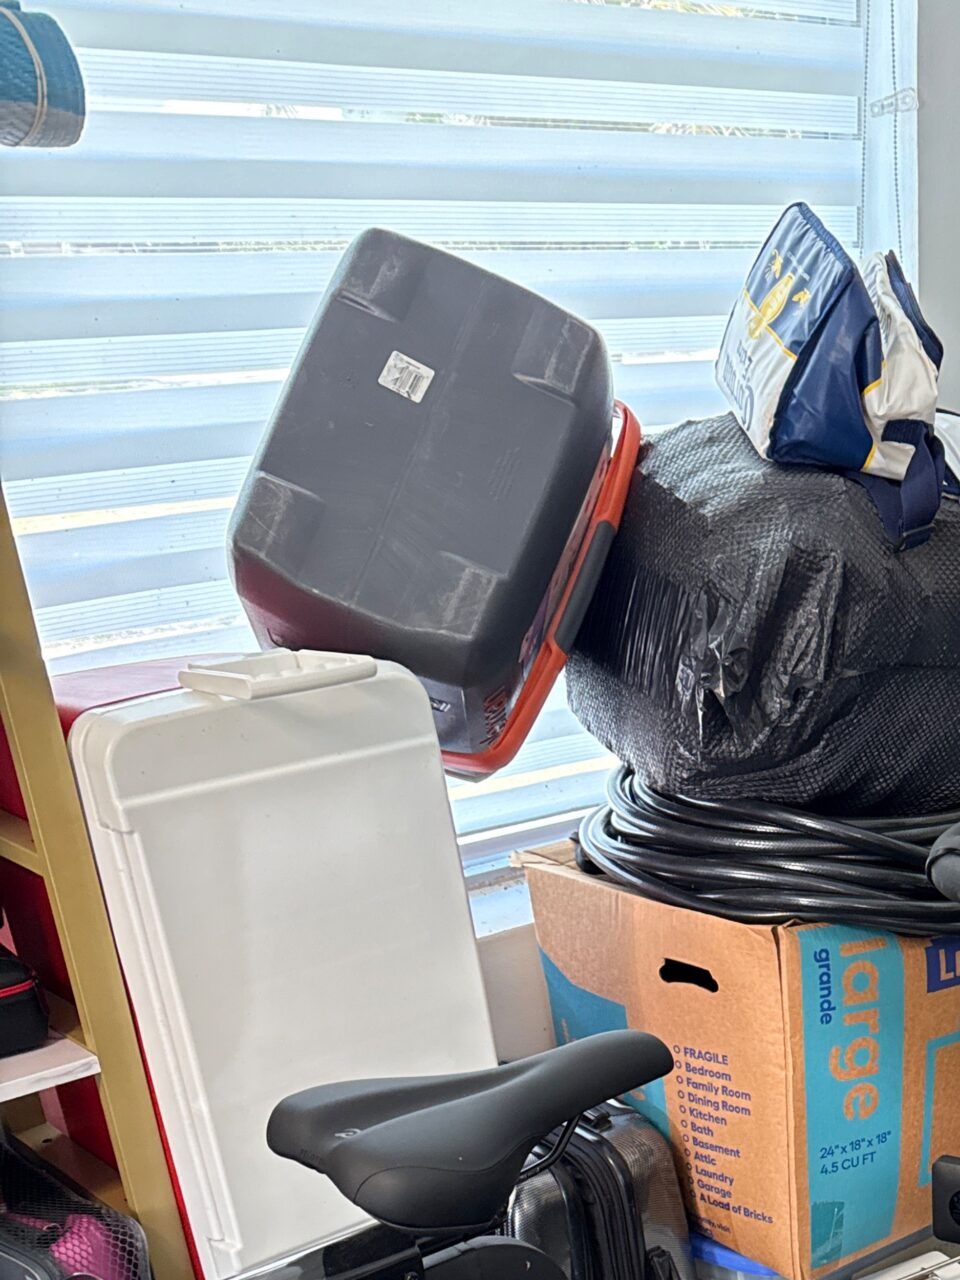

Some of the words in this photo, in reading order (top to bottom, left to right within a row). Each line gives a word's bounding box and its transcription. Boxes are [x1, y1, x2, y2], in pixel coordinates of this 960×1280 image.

[814, 948, 836, 1025] grande
[829, 938, 887, 1121] large
[684, 1047, 728, 1065] FRAGILE
[685, 1062, 732, 1082] Bedroom
[686, 1077, 720, 1096] Family
[722, 1086, 751, 1101] Room
[688, 1092, 720, 1111] Dining
[722, 1101, 750, 1116] Room
[689, 1107, 727, 1126] Kitchen
[691, 1122, 714, 1137] Bath
[692, 1137, 740, 1158] Basement
[694, 1151, 716, 1166] Attic
[820, 1158, 839, 1176] 4.5
[842, 1156, 862, 1170] CU
[862, 1152, 877, 1167] FT
[696, 1165, 734, 1186] Laundry
[697, 1178, 732, 1198] Garage
[700, 1194, 706, 1203] A
[708, 1196, 730, 1210] Load
[732, 1205, 742, 1214] of
[744, 1208, 774, 1224] Bricks
